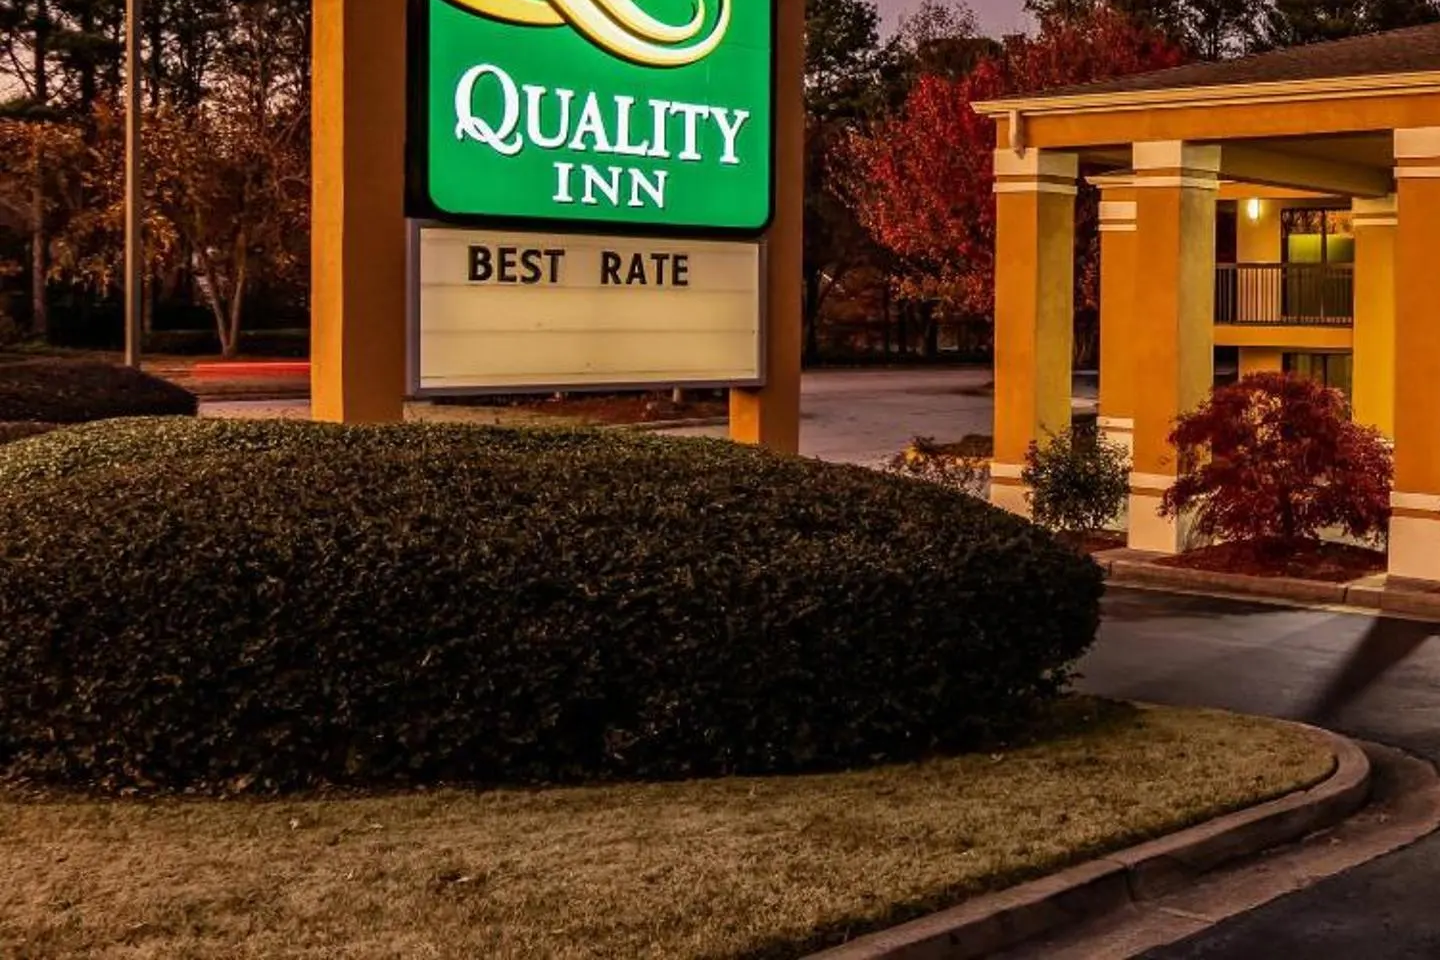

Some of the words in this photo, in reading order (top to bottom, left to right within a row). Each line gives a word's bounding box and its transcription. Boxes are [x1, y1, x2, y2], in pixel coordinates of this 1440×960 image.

[455, 64, 750, 164] QUALITY
[552, 162, 668, 208] INN
[467, 245, 566, 285] BEST
[600, 250, 689, 287] RATE
